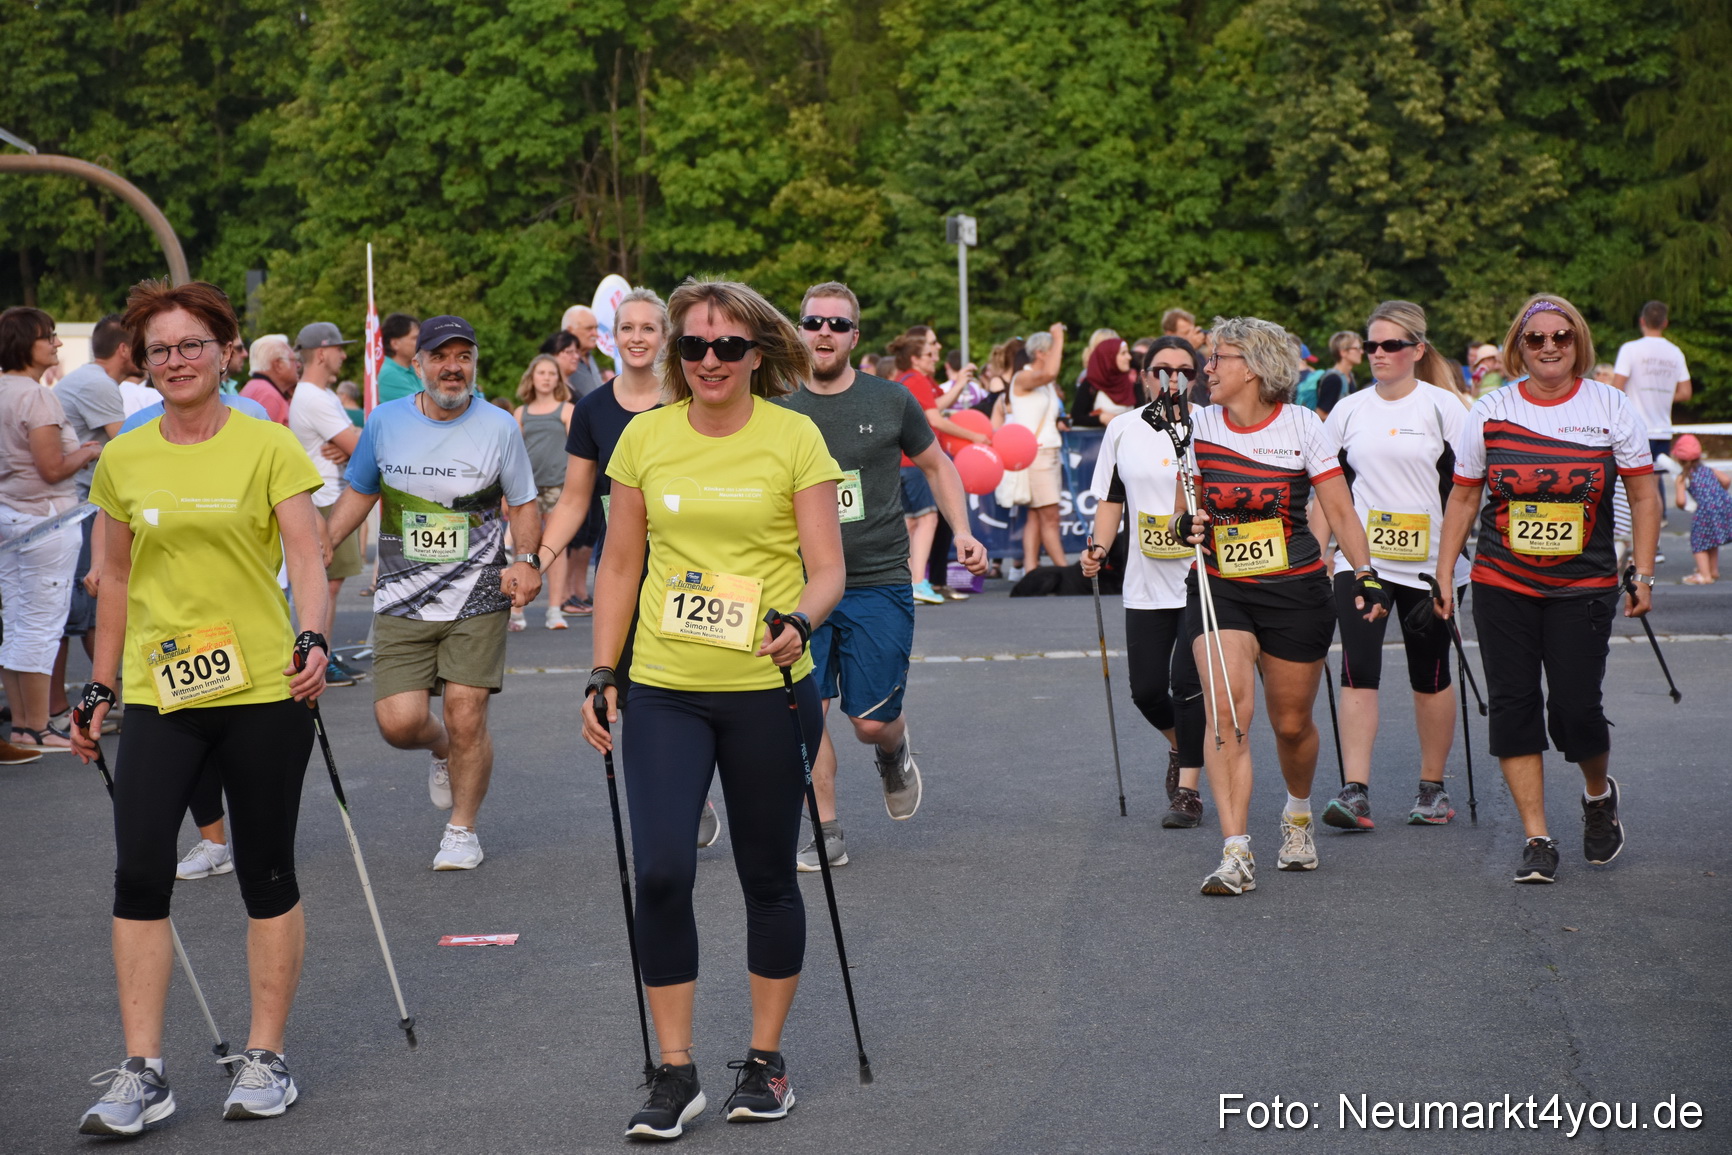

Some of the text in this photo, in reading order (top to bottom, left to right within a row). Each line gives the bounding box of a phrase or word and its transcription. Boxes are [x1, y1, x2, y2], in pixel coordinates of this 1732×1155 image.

[1168, 429, 1181, 448] LEKI
[1558, 426, 1601, 434] NEUMARKT
[1253, 448, 1293, 456] NEUMARKT
[384, 464, 457, 478] RAIL.ONE
[838, 489, 854, 508] 0
[410, 529, 457, 549] 1941
[1143, 529, 1180, 547] 238
[1373, 527, 1419, 548] 2381
[1517, 520, 1573, 541] 2252
[432, 548, 456, 556] Wojciech
[1223, 538, 1274, 563] 2261
[677, 580, 715, 593] firmenlauf
[673, 592, 745, 628] 1295
[680, 628, 726, 640] Klinikum Neumarkt
[684, 621, 724, 633] Simon Eva
[196, 638, 232, 654] walk 2019
[302, 632, 310, 648] LEKI
[161, 648, 231, 690] 1309
[171, 675, 231, 697] Wittmann Irmhild
[180, 691, 201, 701] Klinikum
[201, 684, 225, 696] Neumarkt
